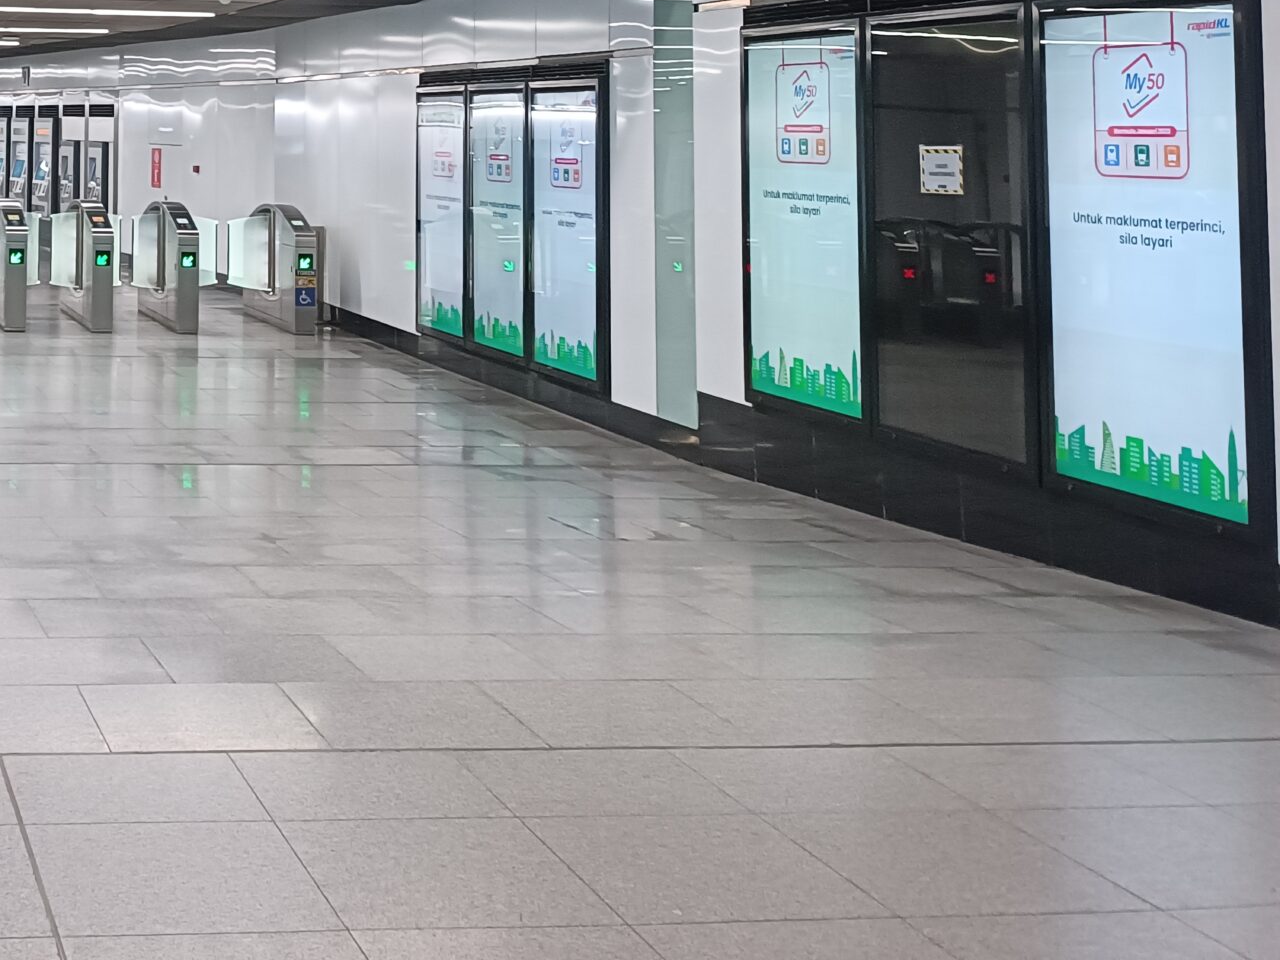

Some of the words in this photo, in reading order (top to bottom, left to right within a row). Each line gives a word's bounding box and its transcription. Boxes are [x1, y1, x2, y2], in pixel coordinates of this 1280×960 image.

[1187, 18, 1230, 31] rapidKL
[1124, 73, 1165, 93] My50
[794, 85, 817, 100] My50
[763, 189, 780, 199] Untuk
[782, 191, 815, 202] maklumat
[1073, 212, 1103, 225] Untuk
[1106, 215, 1162, 229] maklumat
[1165, 218, 1226, 235] terperinci,
[1119, 232, 1138, 245] sila
[1141, 234, 1173, 250] layari
